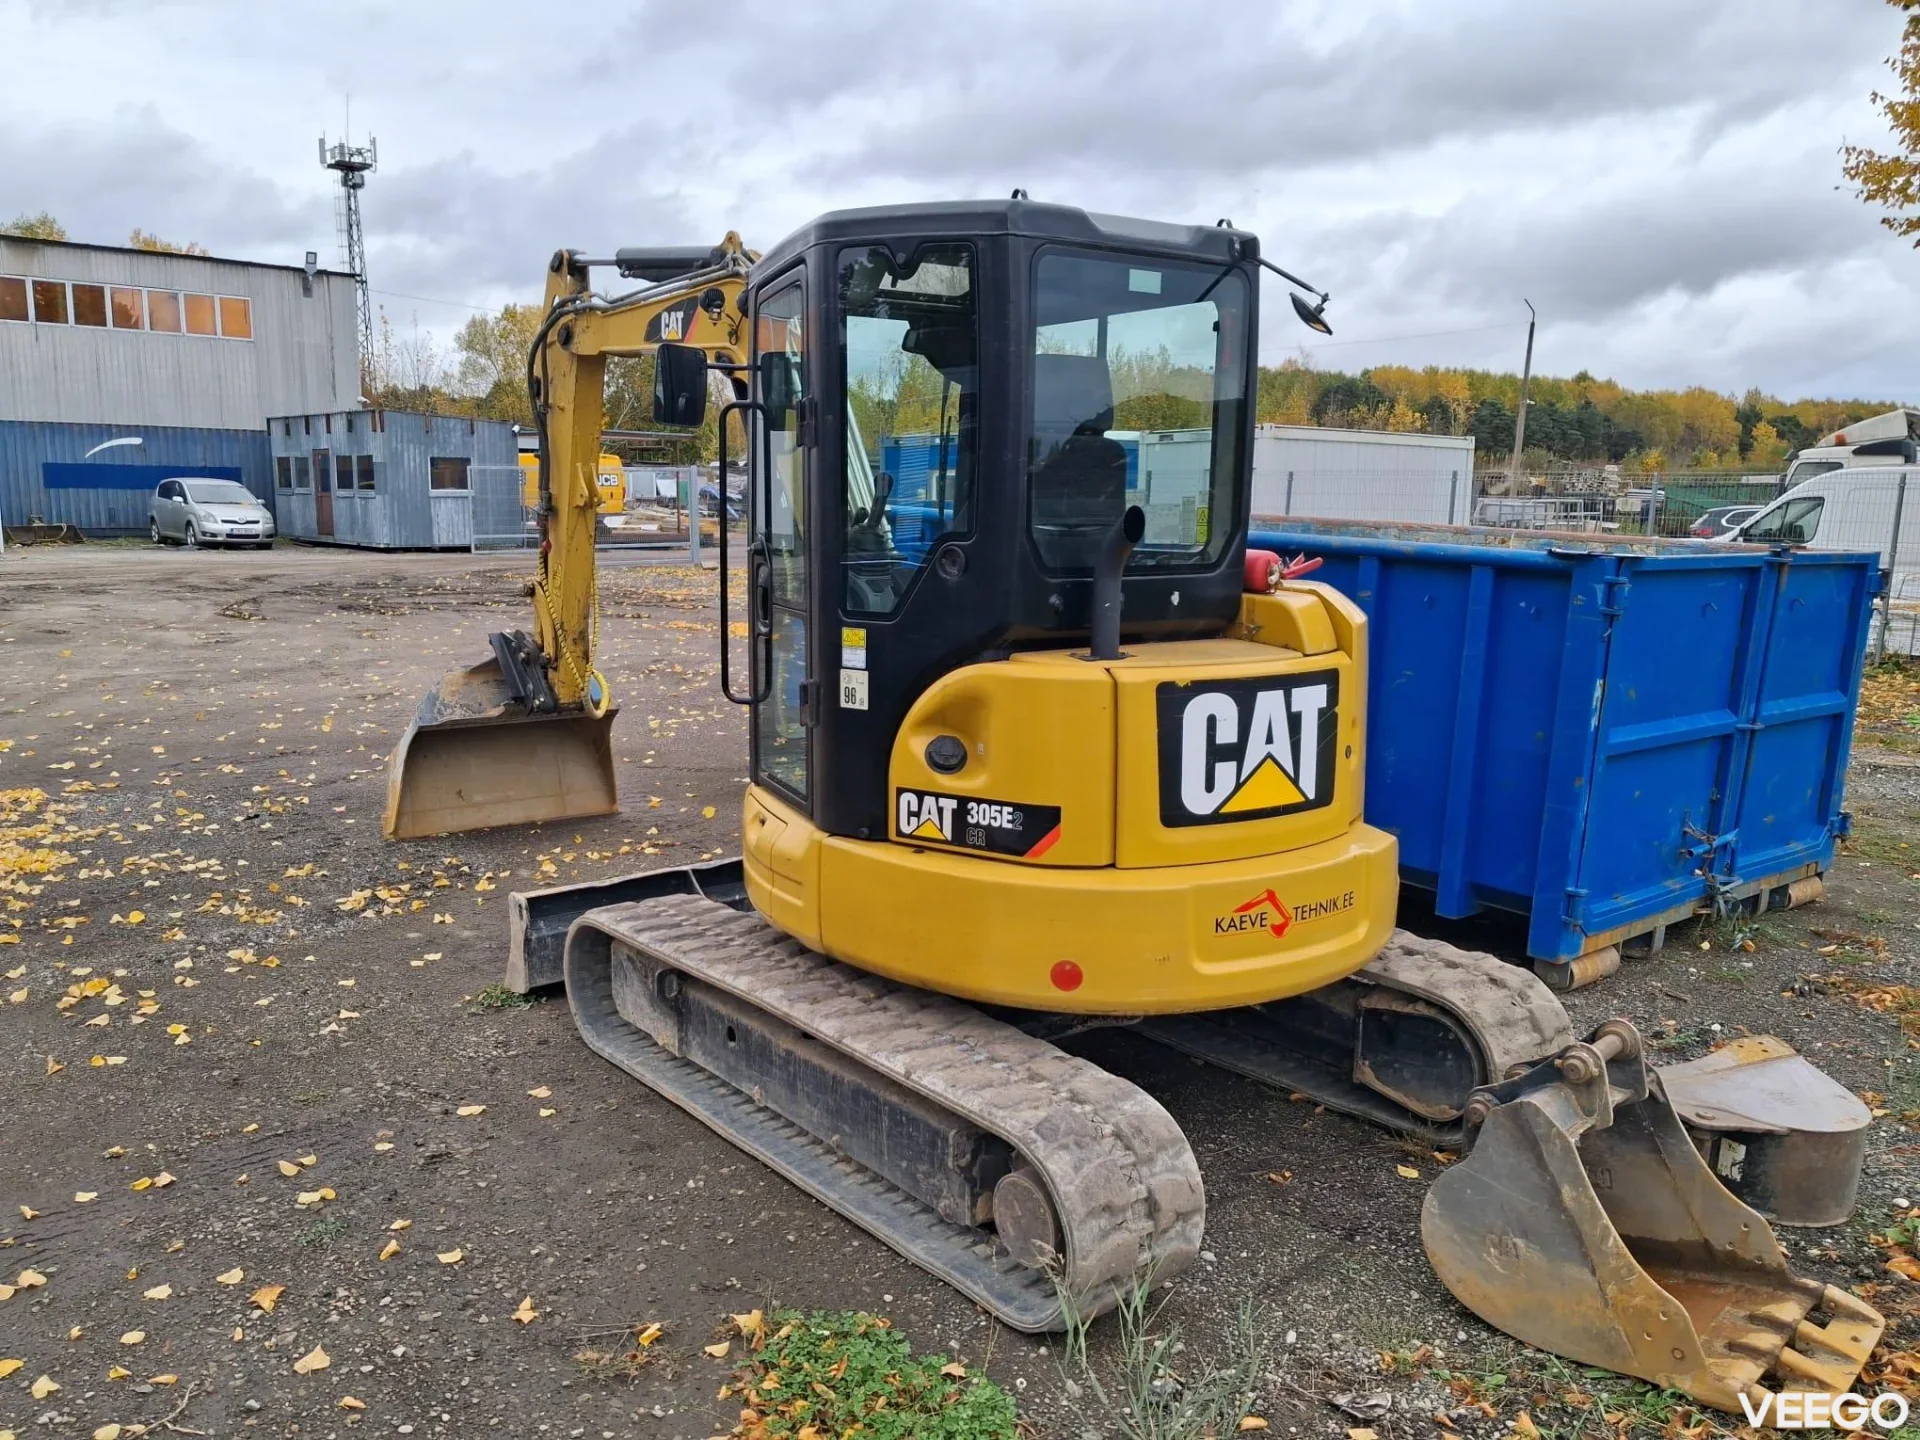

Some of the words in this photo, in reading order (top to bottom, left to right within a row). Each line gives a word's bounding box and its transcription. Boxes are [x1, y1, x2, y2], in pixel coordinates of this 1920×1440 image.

[661, 311, 684, 340] CAT
[844, 686, 857, 705] 96
[1181, 684, 1328, 815] CAT
[899, 791, 958, 842] CAT
[966, 826, 986, 847] CR
[1215, 911, 1268, 933] KAEVE
[1293, 891, 1355, 923] TEHNIK.EE
